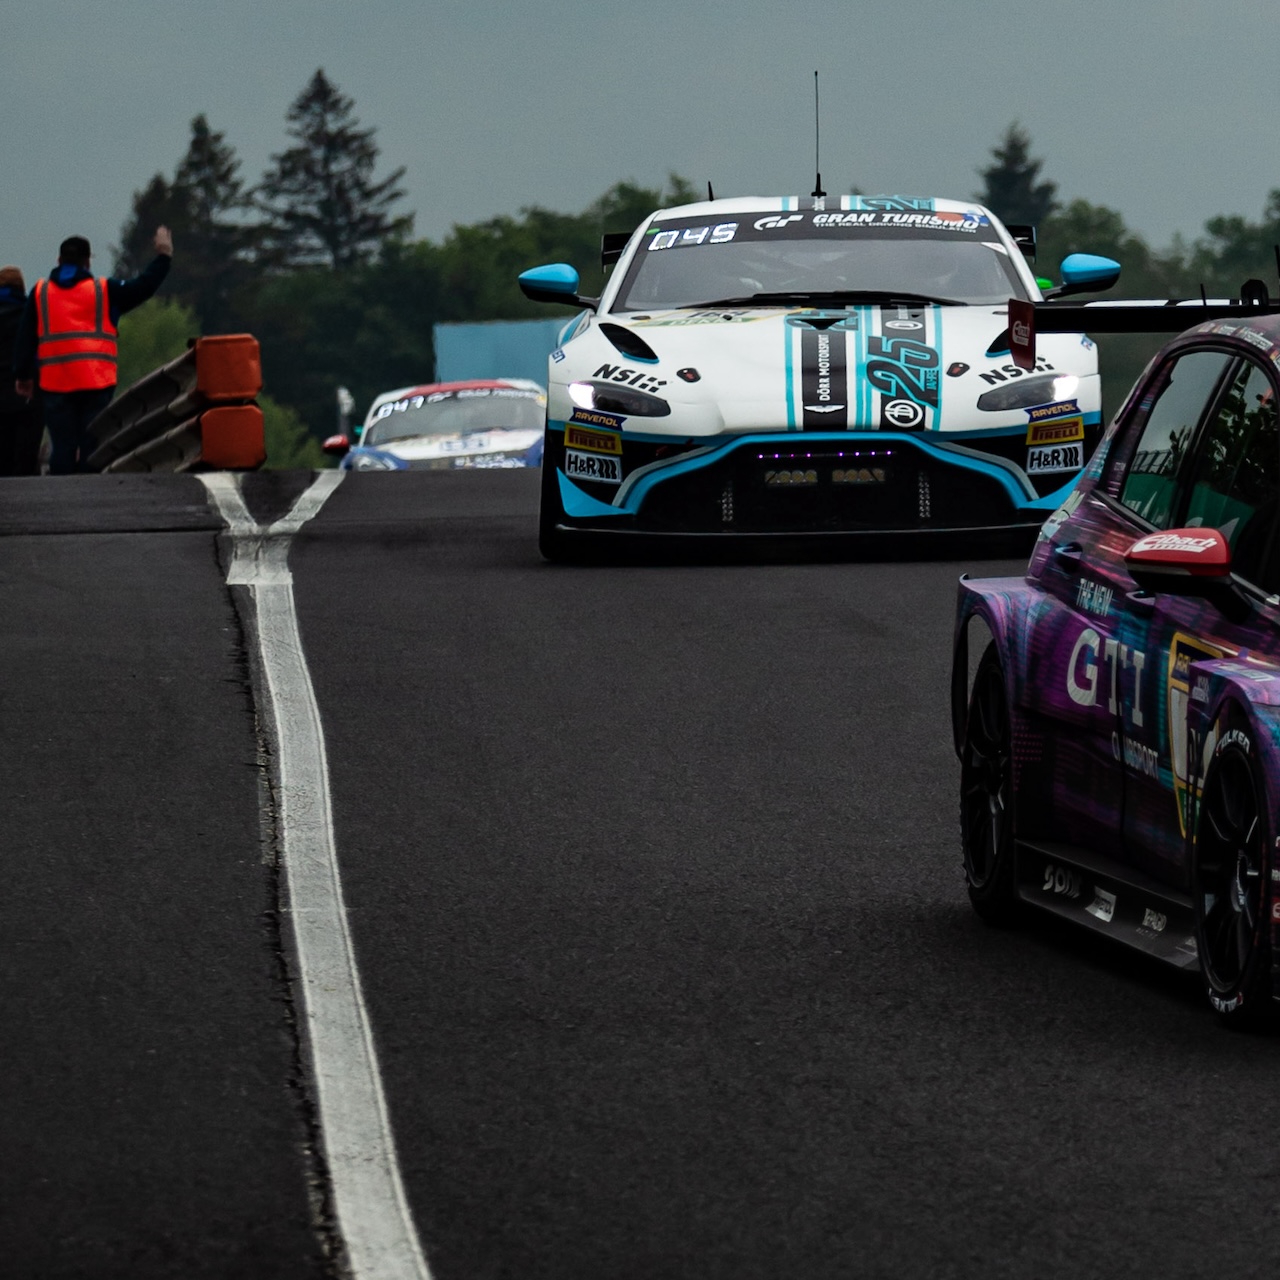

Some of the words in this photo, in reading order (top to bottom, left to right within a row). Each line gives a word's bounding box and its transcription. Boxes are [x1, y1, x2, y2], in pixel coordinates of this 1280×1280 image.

[812, 212, 880, 224] GRAN
[881, 212, 979, 230] TURISMO
[648, 222, 739, 251] 045
[866, 335, 940, 410] 25
[574, 411, 619, 427] RAVENOL
[1032, 402, 1077, 418] RAVENOL
[1031, 420, 1080, 442] PIRELLI
[567, 452, 598, 476] H&R
[1029, 448, 1062, 469] H&R
[1067, 628, 1146, 728] GTI
